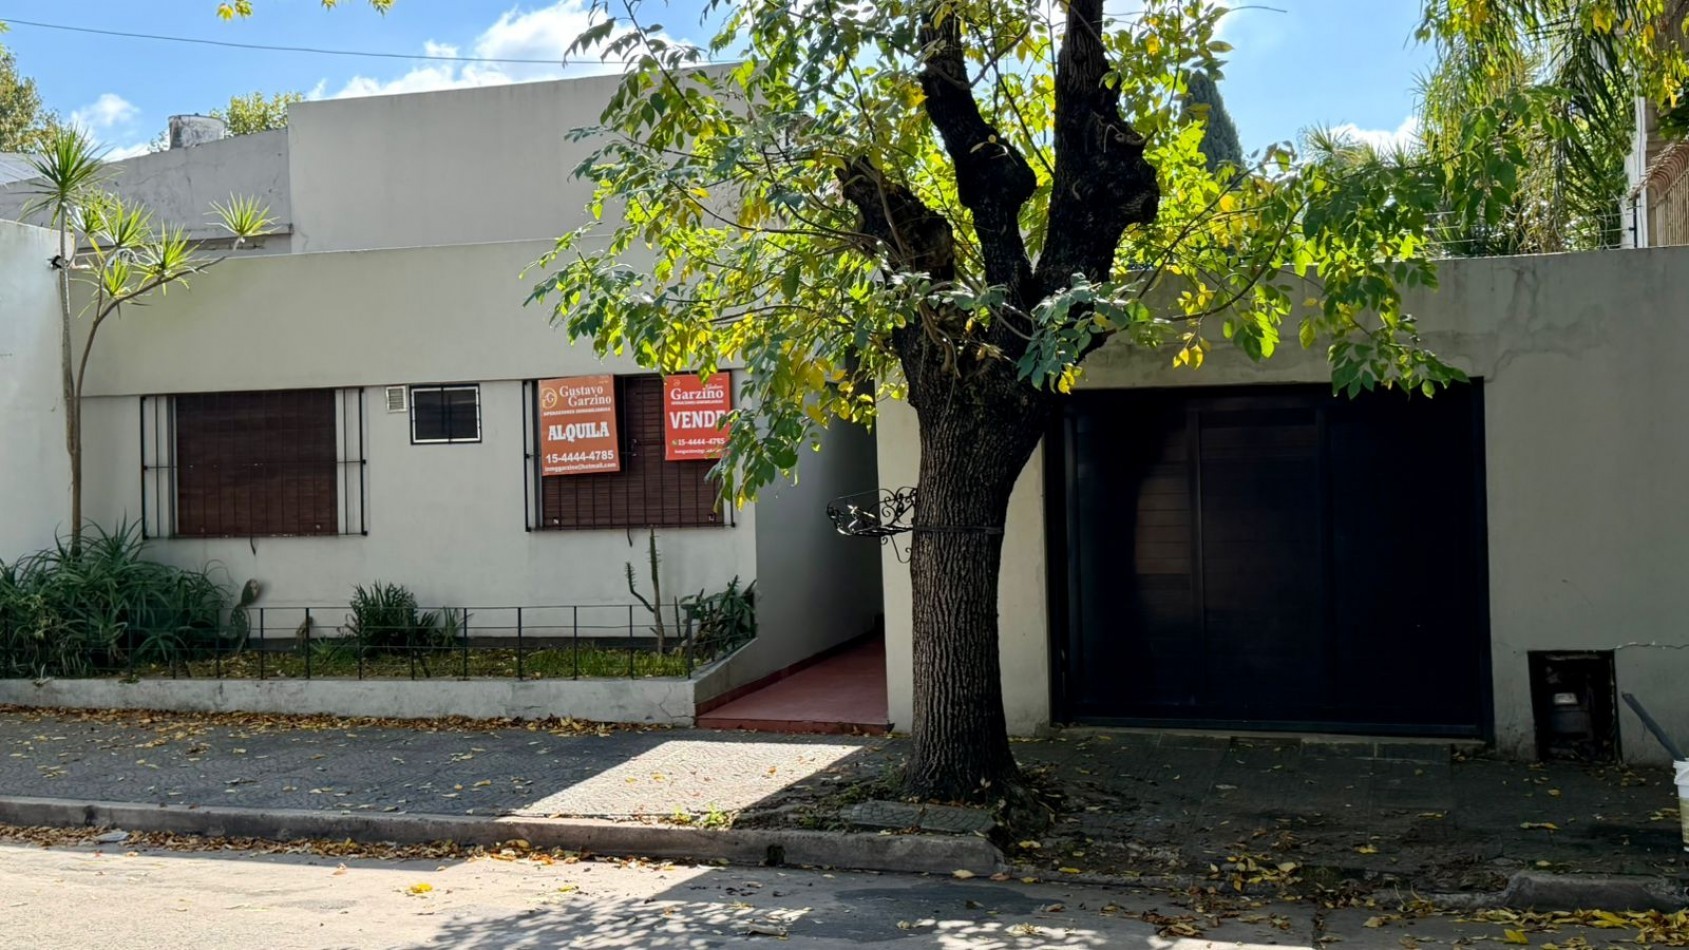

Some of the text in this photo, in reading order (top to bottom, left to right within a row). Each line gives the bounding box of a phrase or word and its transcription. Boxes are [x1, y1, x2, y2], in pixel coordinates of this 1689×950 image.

[559, 385, 604, 398] Gustavo
[670, 387, 724, 401] Garzino
[568, 394, 612, 407] Garzino
[547, 421, 610, 442] ALQUILA
[545, 449, 614, 464] 15-4444-4785
